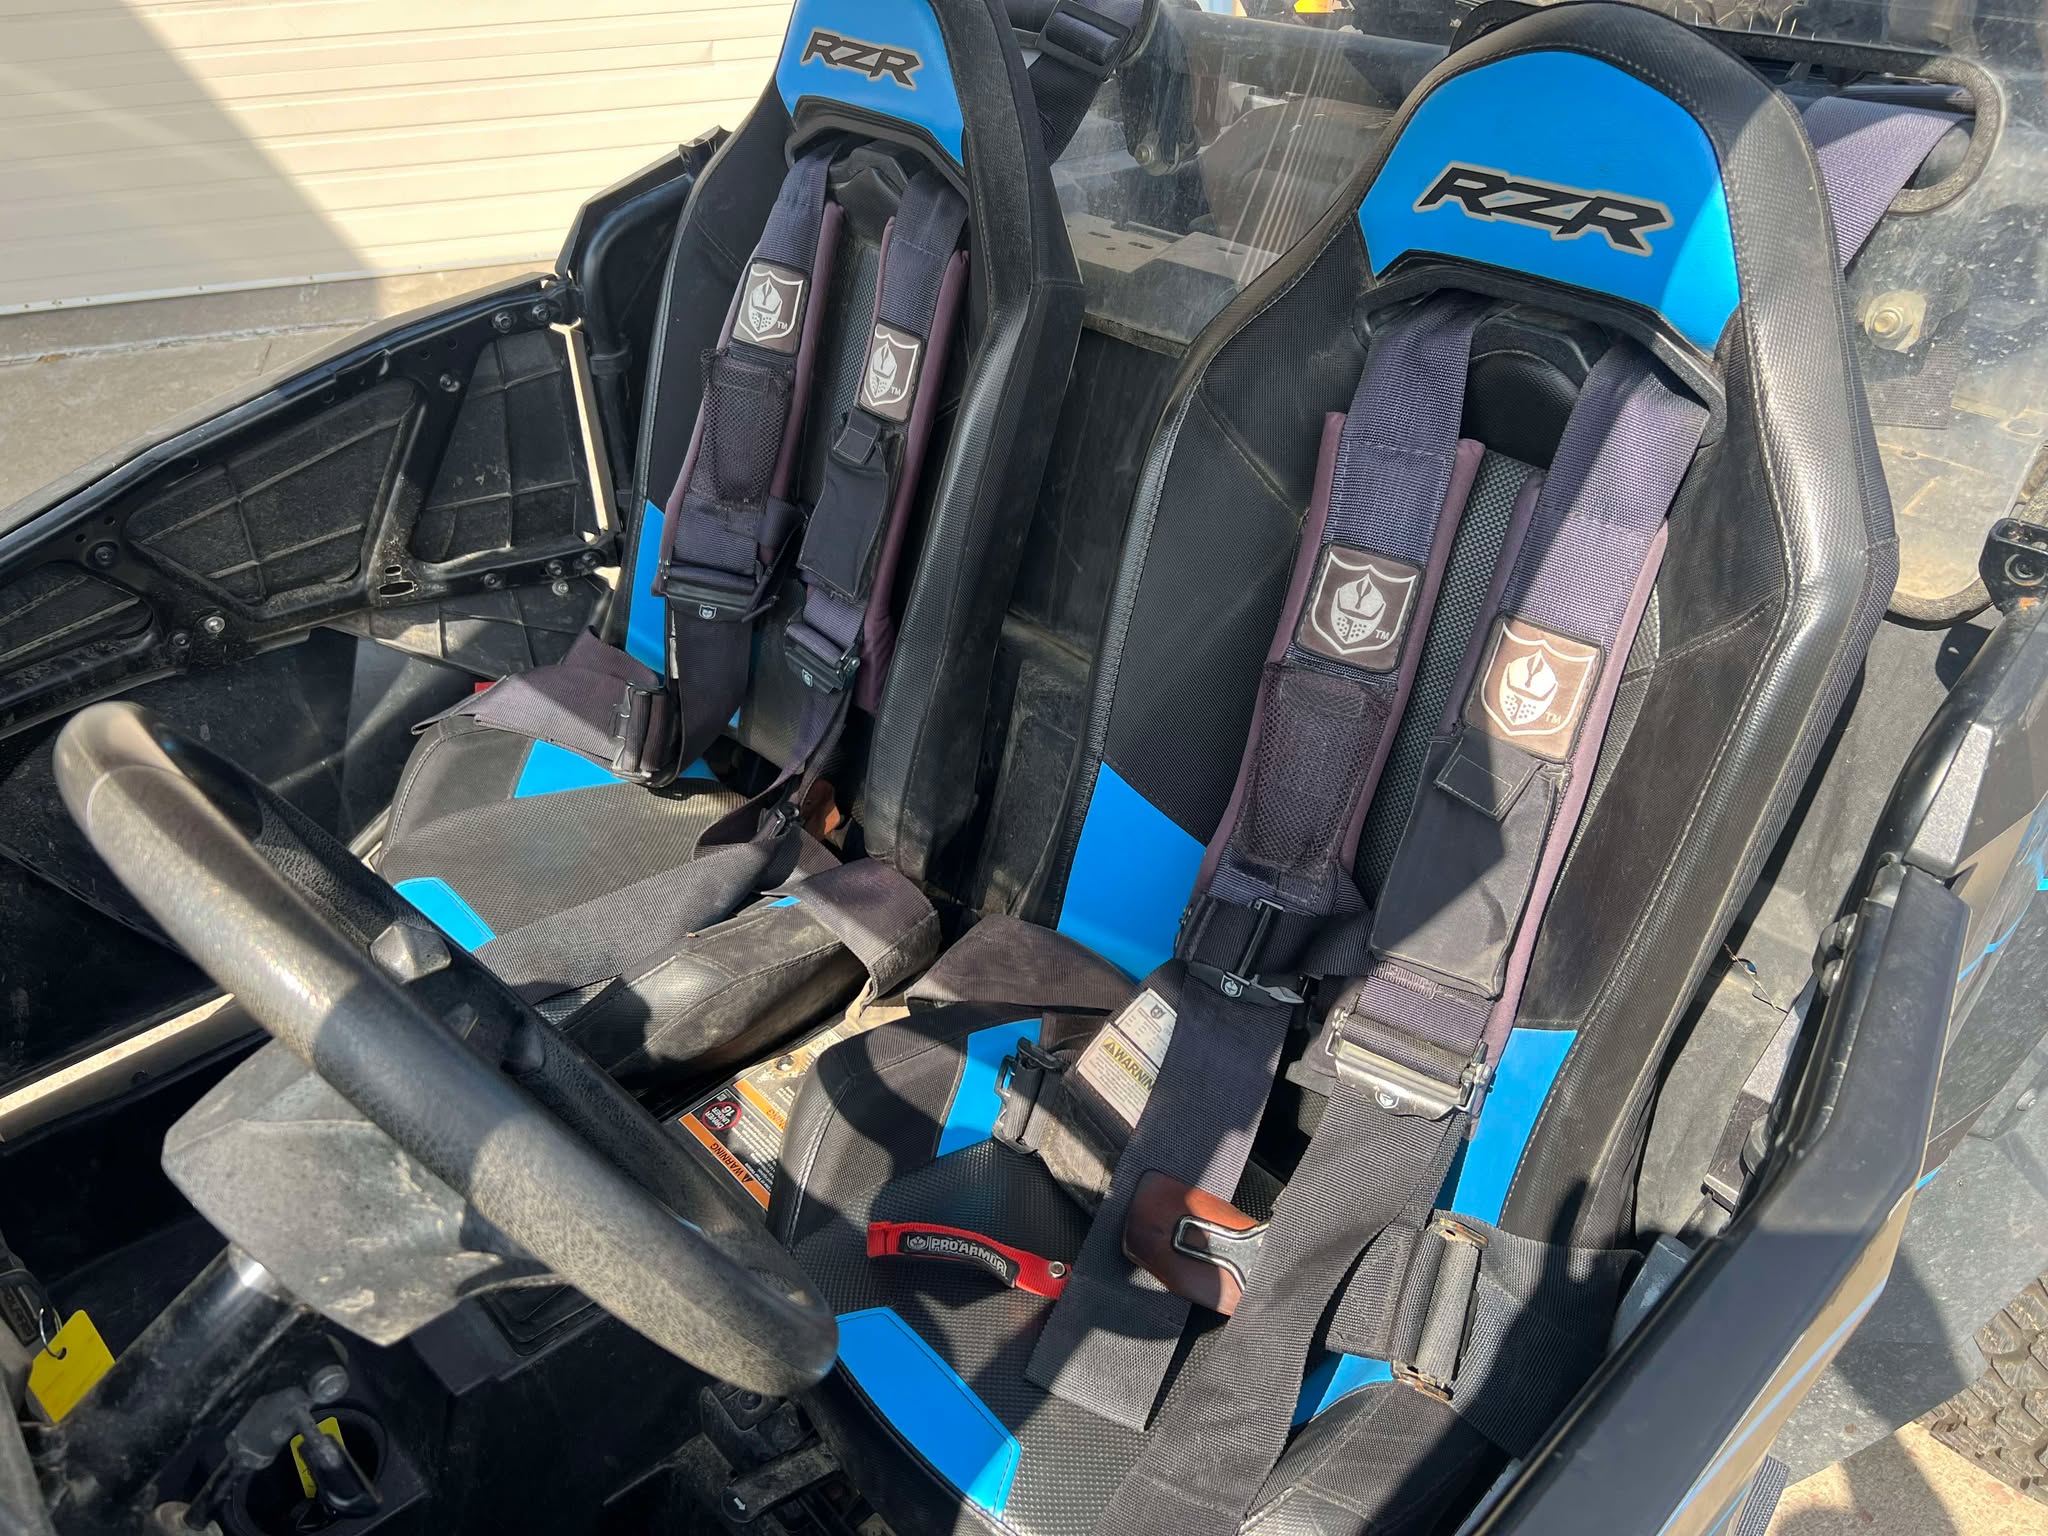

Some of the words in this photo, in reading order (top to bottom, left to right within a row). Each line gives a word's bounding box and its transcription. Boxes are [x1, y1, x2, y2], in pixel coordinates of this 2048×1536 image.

[801, 30, 922, 88] RZR
[1416, 165, 1668, 252] RZR
[1375, 629, 1391, 641] TM
[1545, 711, 1562, 724] TM
[1113, 1047, 1156, 1091] WARNIN
[704, 1110, 724, 1128] DRIVER
[711, 1106, 730, 1125] UNDER
[721, 1105, 735, 1116] 16
[710, 1142, 744, 1177] WARNING
